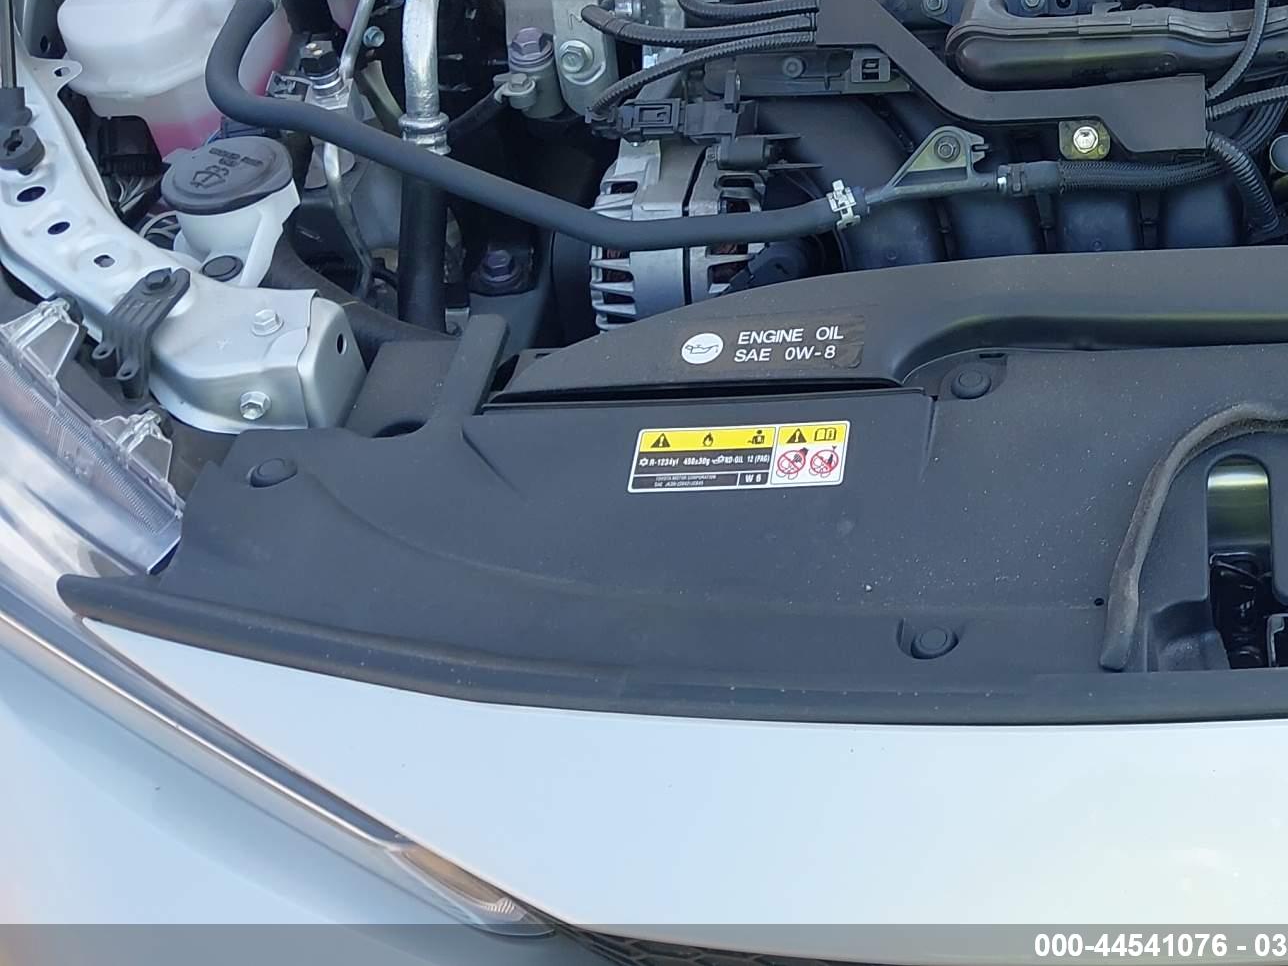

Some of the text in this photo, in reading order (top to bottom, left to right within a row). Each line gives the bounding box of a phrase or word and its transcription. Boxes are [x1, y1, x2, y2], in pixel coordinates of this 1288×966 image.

[737, 325, 845, 345] ENGINE OIL
[733, 344, 837, 363] SAE 0W-8
